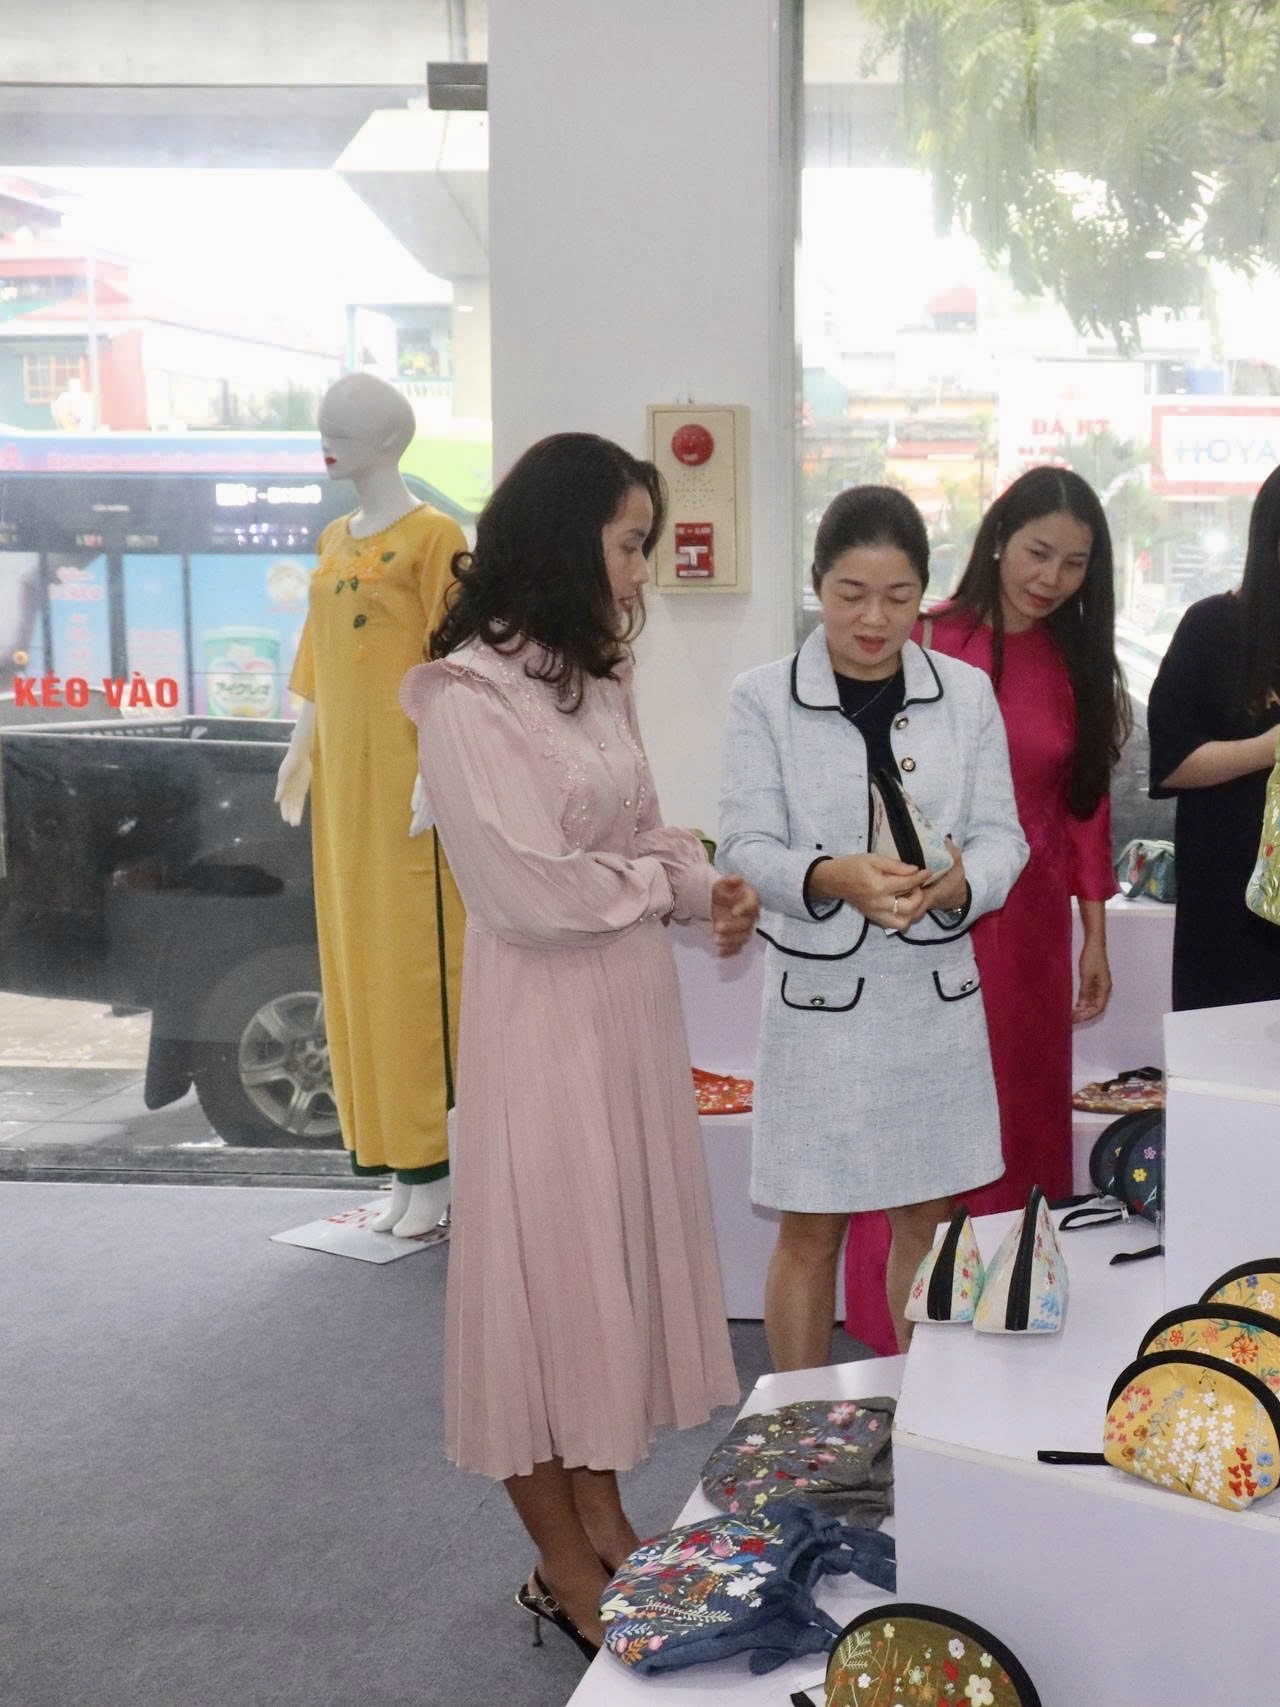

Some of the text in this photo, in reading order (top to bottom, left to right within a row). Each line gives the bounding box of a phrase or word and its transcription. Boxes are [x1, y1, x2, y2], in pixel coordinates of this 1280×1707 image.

[1175, 438, 1279, 464] HOYA
[13, 669, 179, 708] KÉO VÀO
